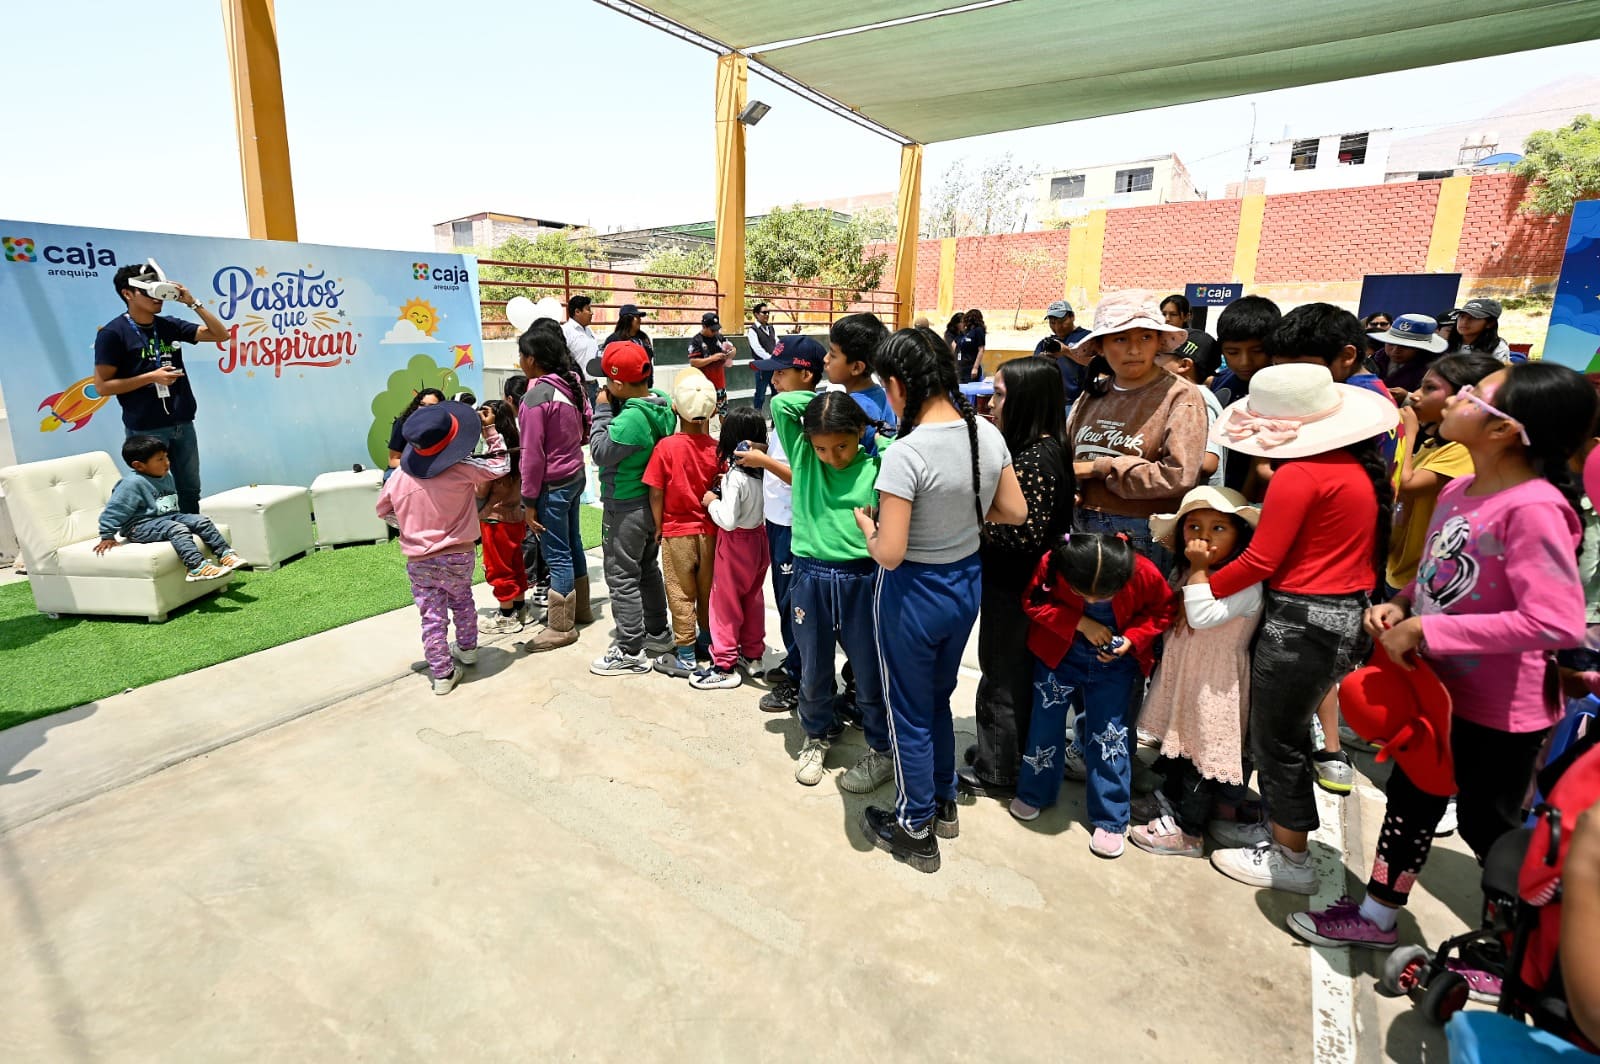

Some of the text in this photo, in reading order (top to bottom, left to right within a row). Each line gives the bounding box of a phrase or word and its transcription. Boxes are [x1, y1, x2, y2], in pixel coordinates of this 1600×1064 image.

[43, 242, 117, 269] caja
[48, 269, 98, 278] arequipa
[432, 265, 469, 285] caja
[212, 266, 345, 320] Pasitos
[1207, 287, 1232, 299] caja
[272, 310, 308, 335] que
[216, 324, 357, 378] Inspiran
[1075, 425, 1145, 458] New York
